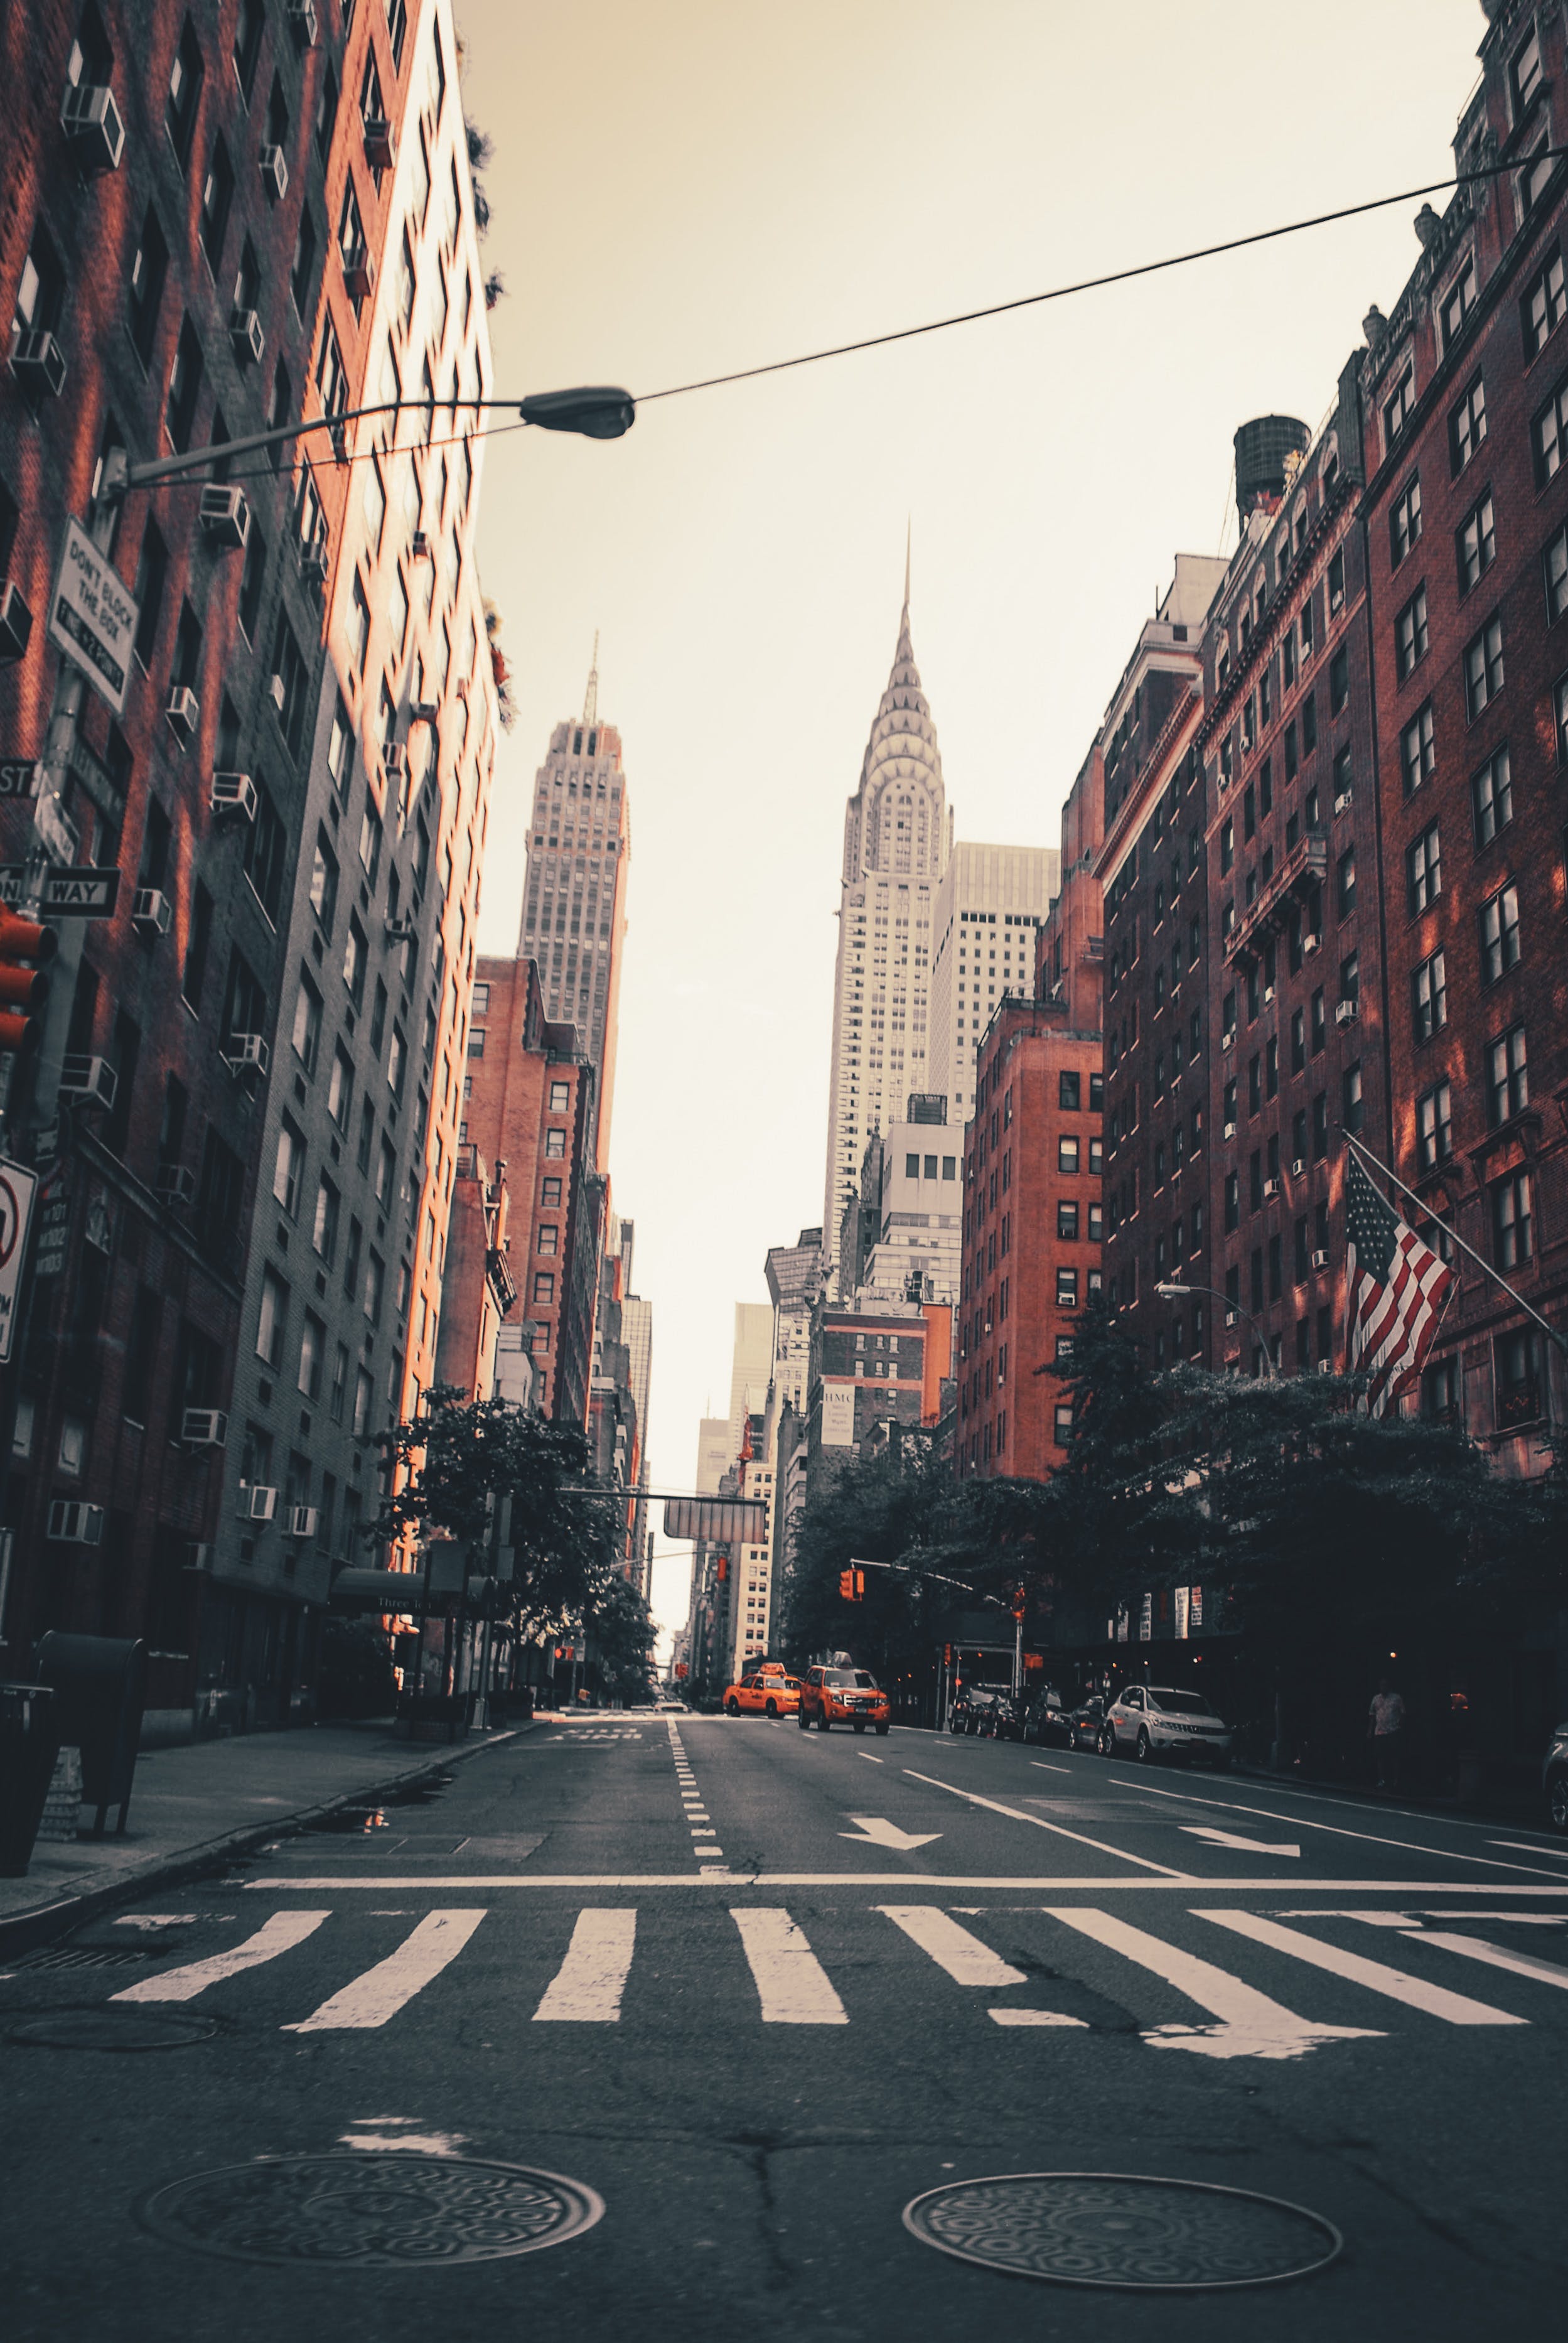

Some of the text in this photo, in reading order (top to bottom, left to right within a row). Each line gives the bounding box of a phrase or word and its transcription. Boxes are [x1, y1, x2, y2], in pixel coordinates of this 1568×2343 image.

[80, 578, 99, 618] THE
[99, 606, 119, 641] BOX
[1, 765, 30, 793] ST
[53, 881, 99, 903] WAY
